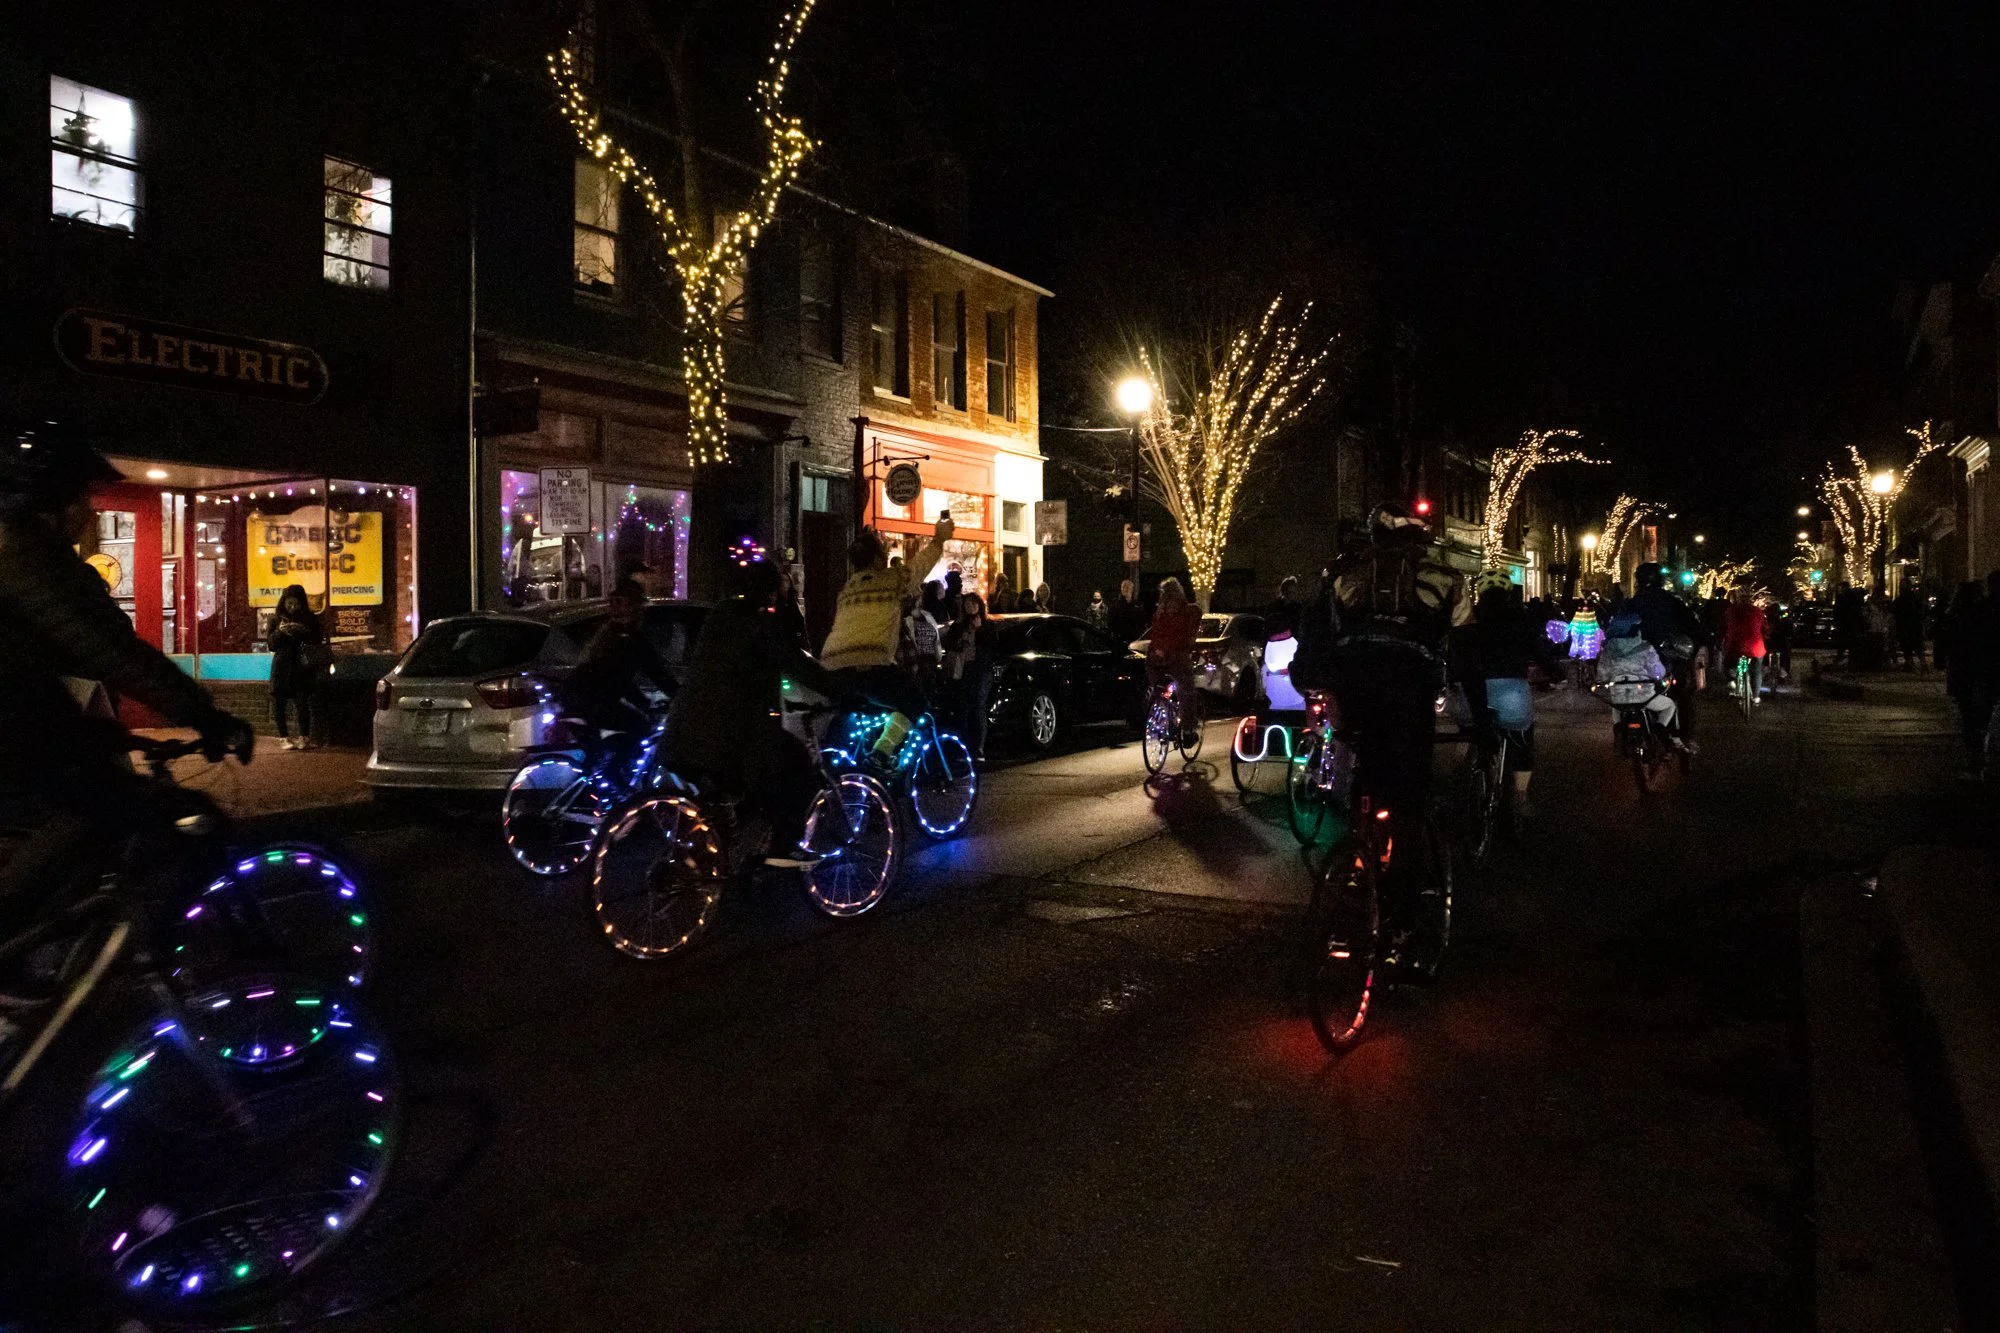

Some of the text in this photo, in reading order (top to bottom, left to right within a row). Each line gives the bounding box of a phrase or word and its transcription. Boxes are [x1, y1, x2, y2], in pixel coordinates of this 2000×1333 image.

[82, 316, 310, 388] ELECTRIC
[556, 470, 572, 478] NO
[564, 518, 582, 526] FINE
[265, 523, 361, 545] CLASIC
[260, 585, 375, 596] TATT PIERCING
[337, 610, 371, 618] BRIGHT
[335, 625, 370, 633] FOREVER
